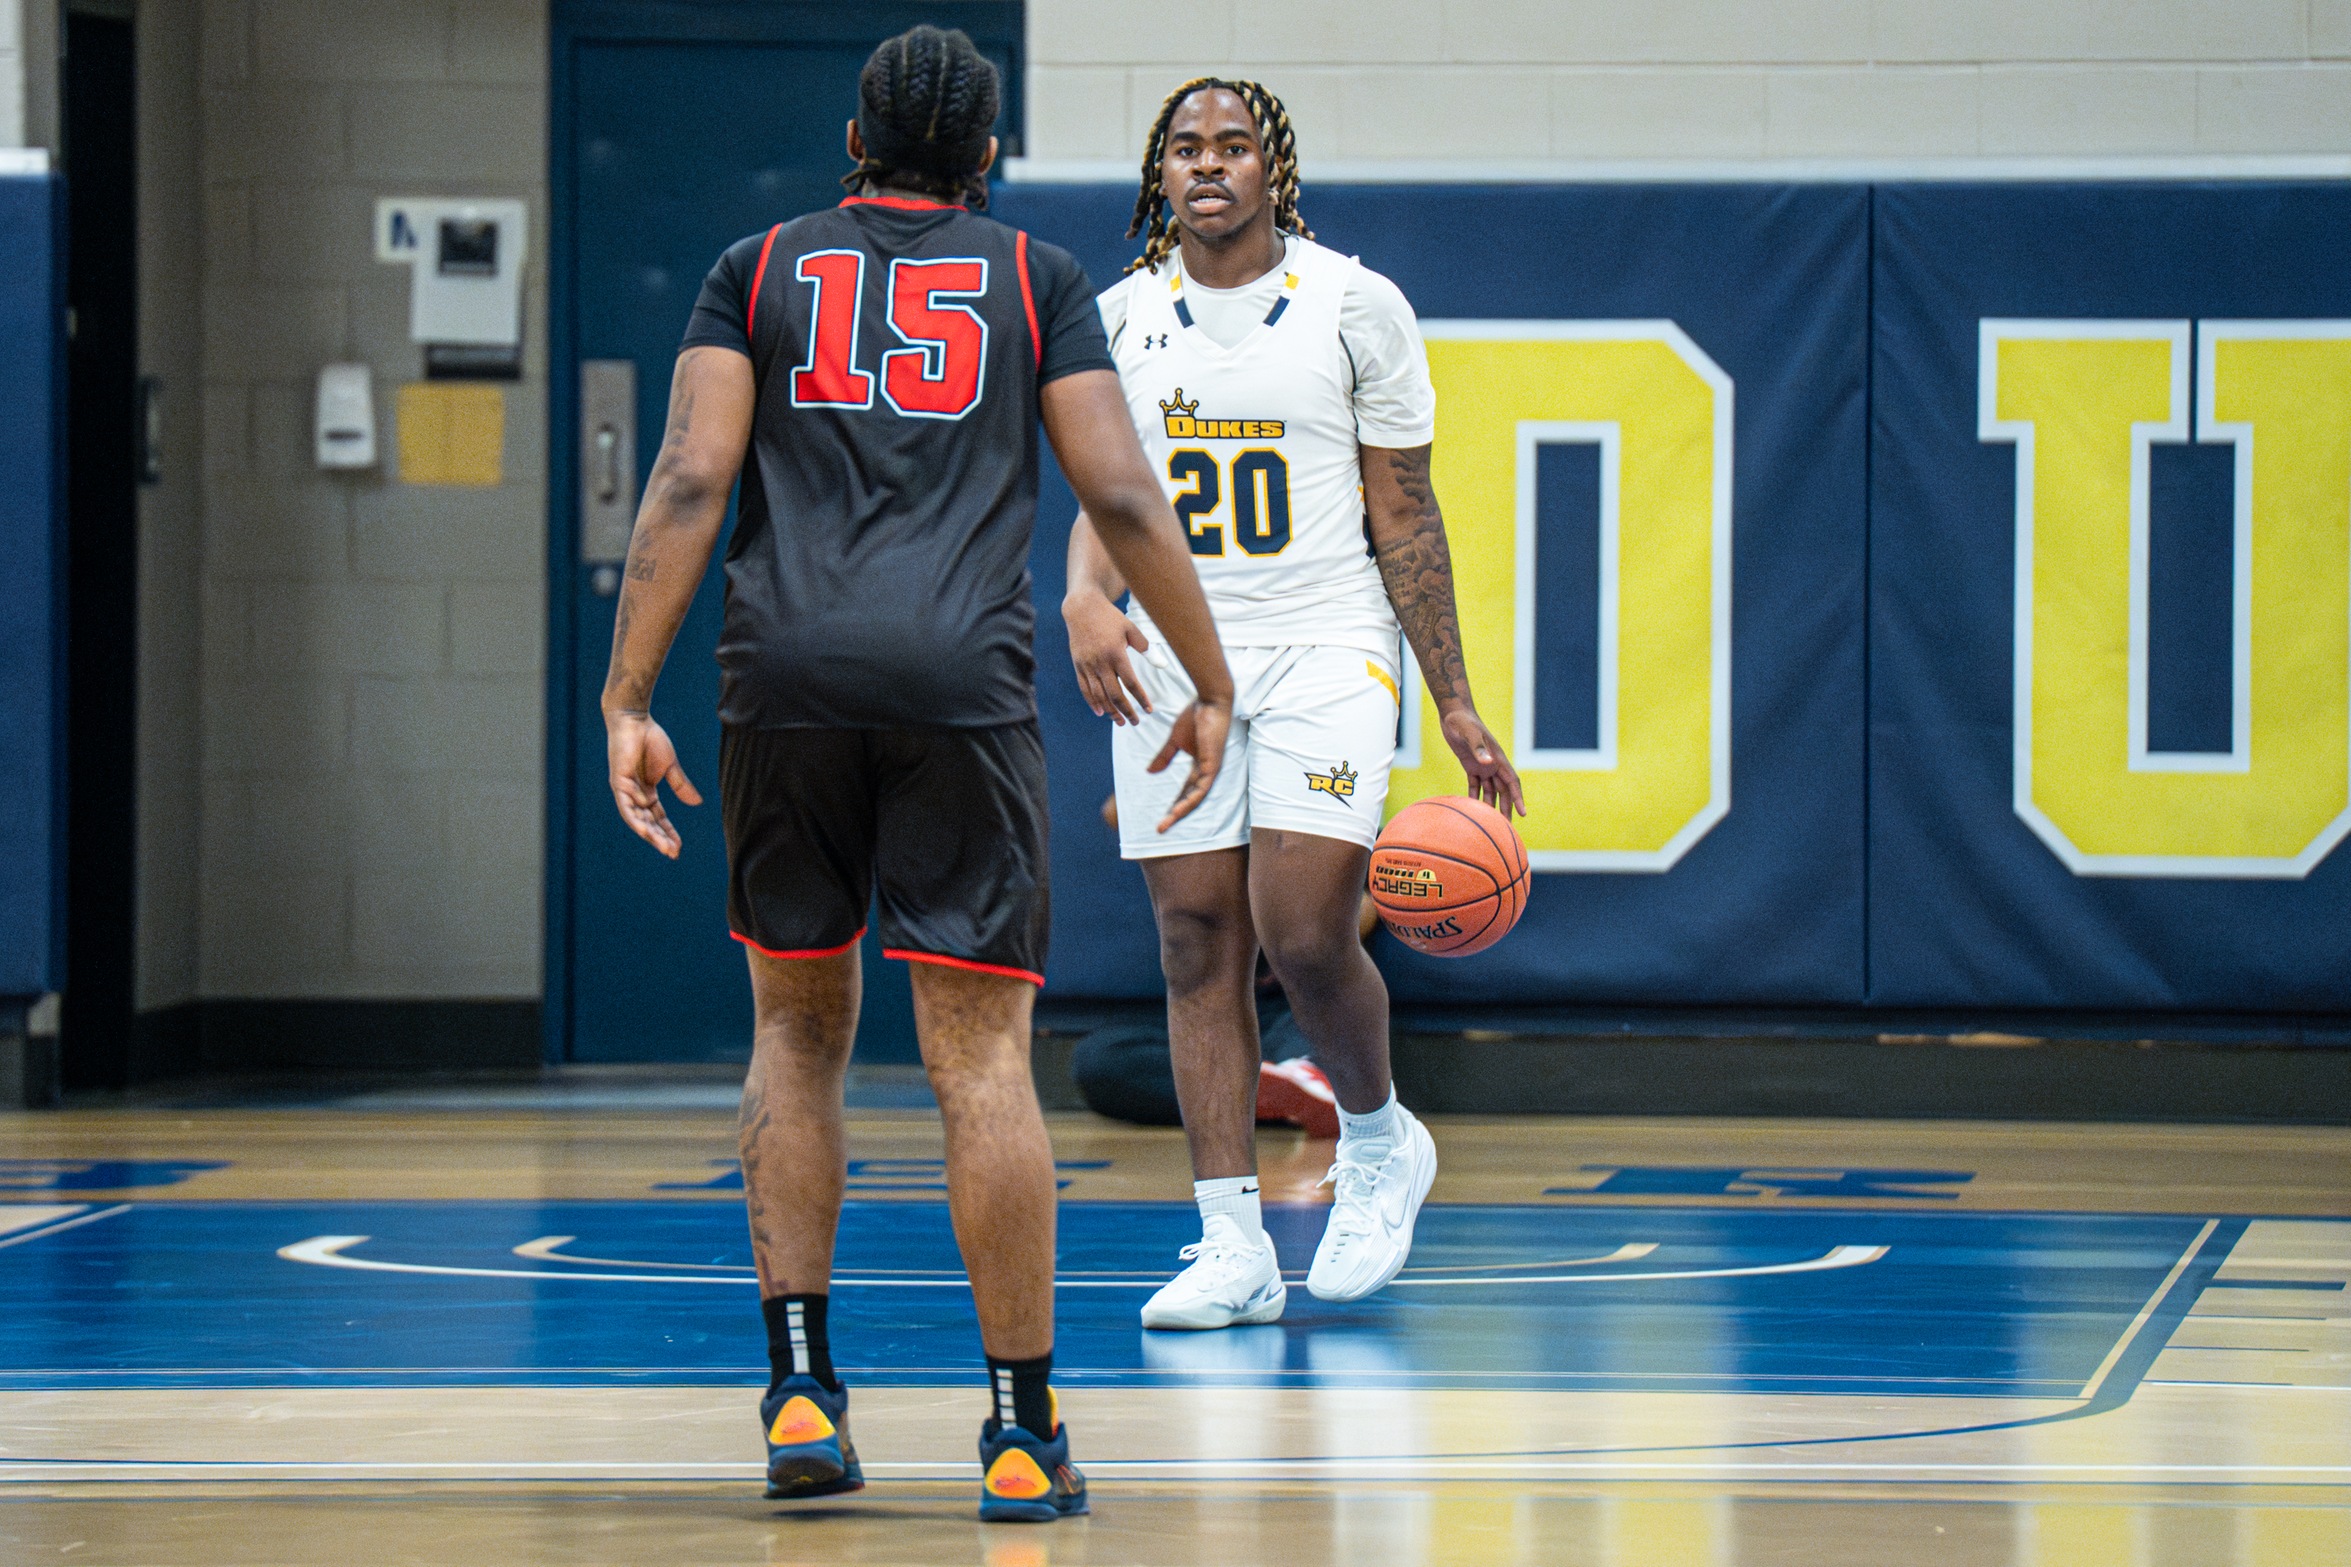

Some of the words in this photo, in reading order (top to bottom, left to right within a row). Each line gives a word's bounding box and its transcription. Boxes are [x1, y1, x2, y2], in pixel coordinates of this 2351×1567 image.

[790, 249, 989, 421] 15
[1165, 415, 1285, 439] DUKES
[1167, 447, 1294, 558] 20
[1304, 772, 1354, 809] RC
[1372, 875, 1443, 899] LEGACY
